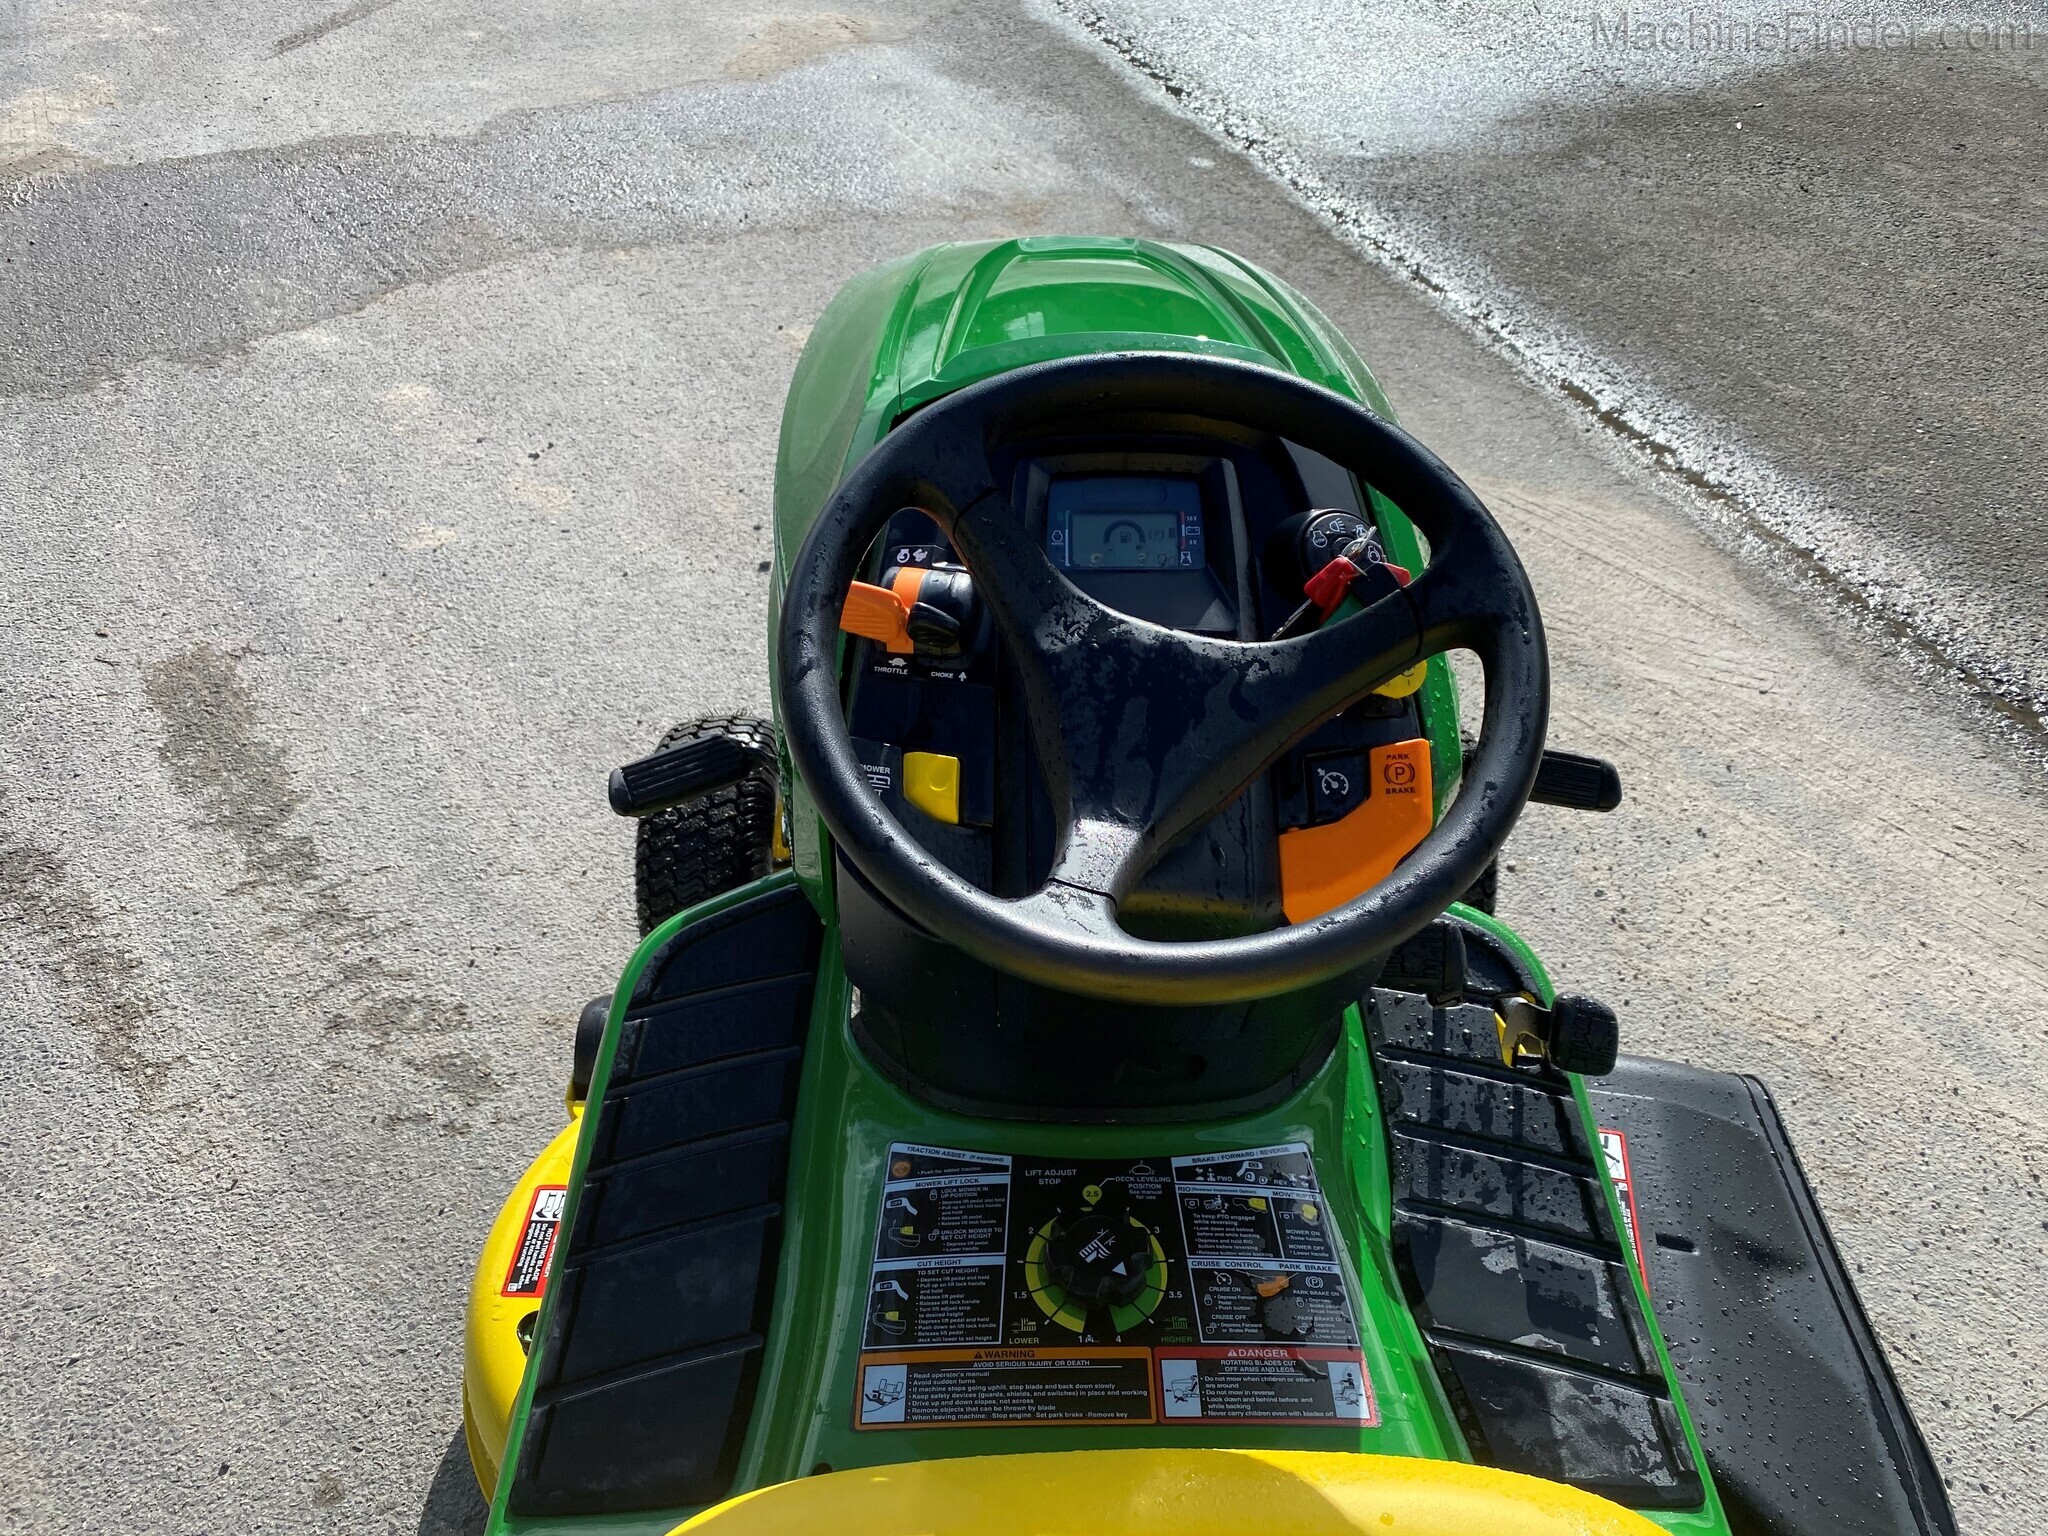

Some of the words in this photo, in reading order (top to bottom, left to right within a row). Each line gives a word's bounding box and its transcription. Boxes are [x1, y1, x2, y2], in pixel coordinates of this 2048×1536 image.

[874, 666, 908, 675] THROTTLE
[1386, 786, 1416, 794] BRAKE
[907, 1146, 940, 1155] TRACTION
[942, 1151, 966, 1159] ASSIST
[1222, 1152, 1255, 1160] FORWARD
[1260, 1147, 1289, 1156] REVERSE
[538, 1228, 553, 1259] ROTATING
[532, 1260, 545, 1282] BLADE
[1169, 1291, 1183, 1299] 3.5
[984, 1350, 1035, 1358] WARNING
[1239, 1350, 1288, 1358] DANGER
